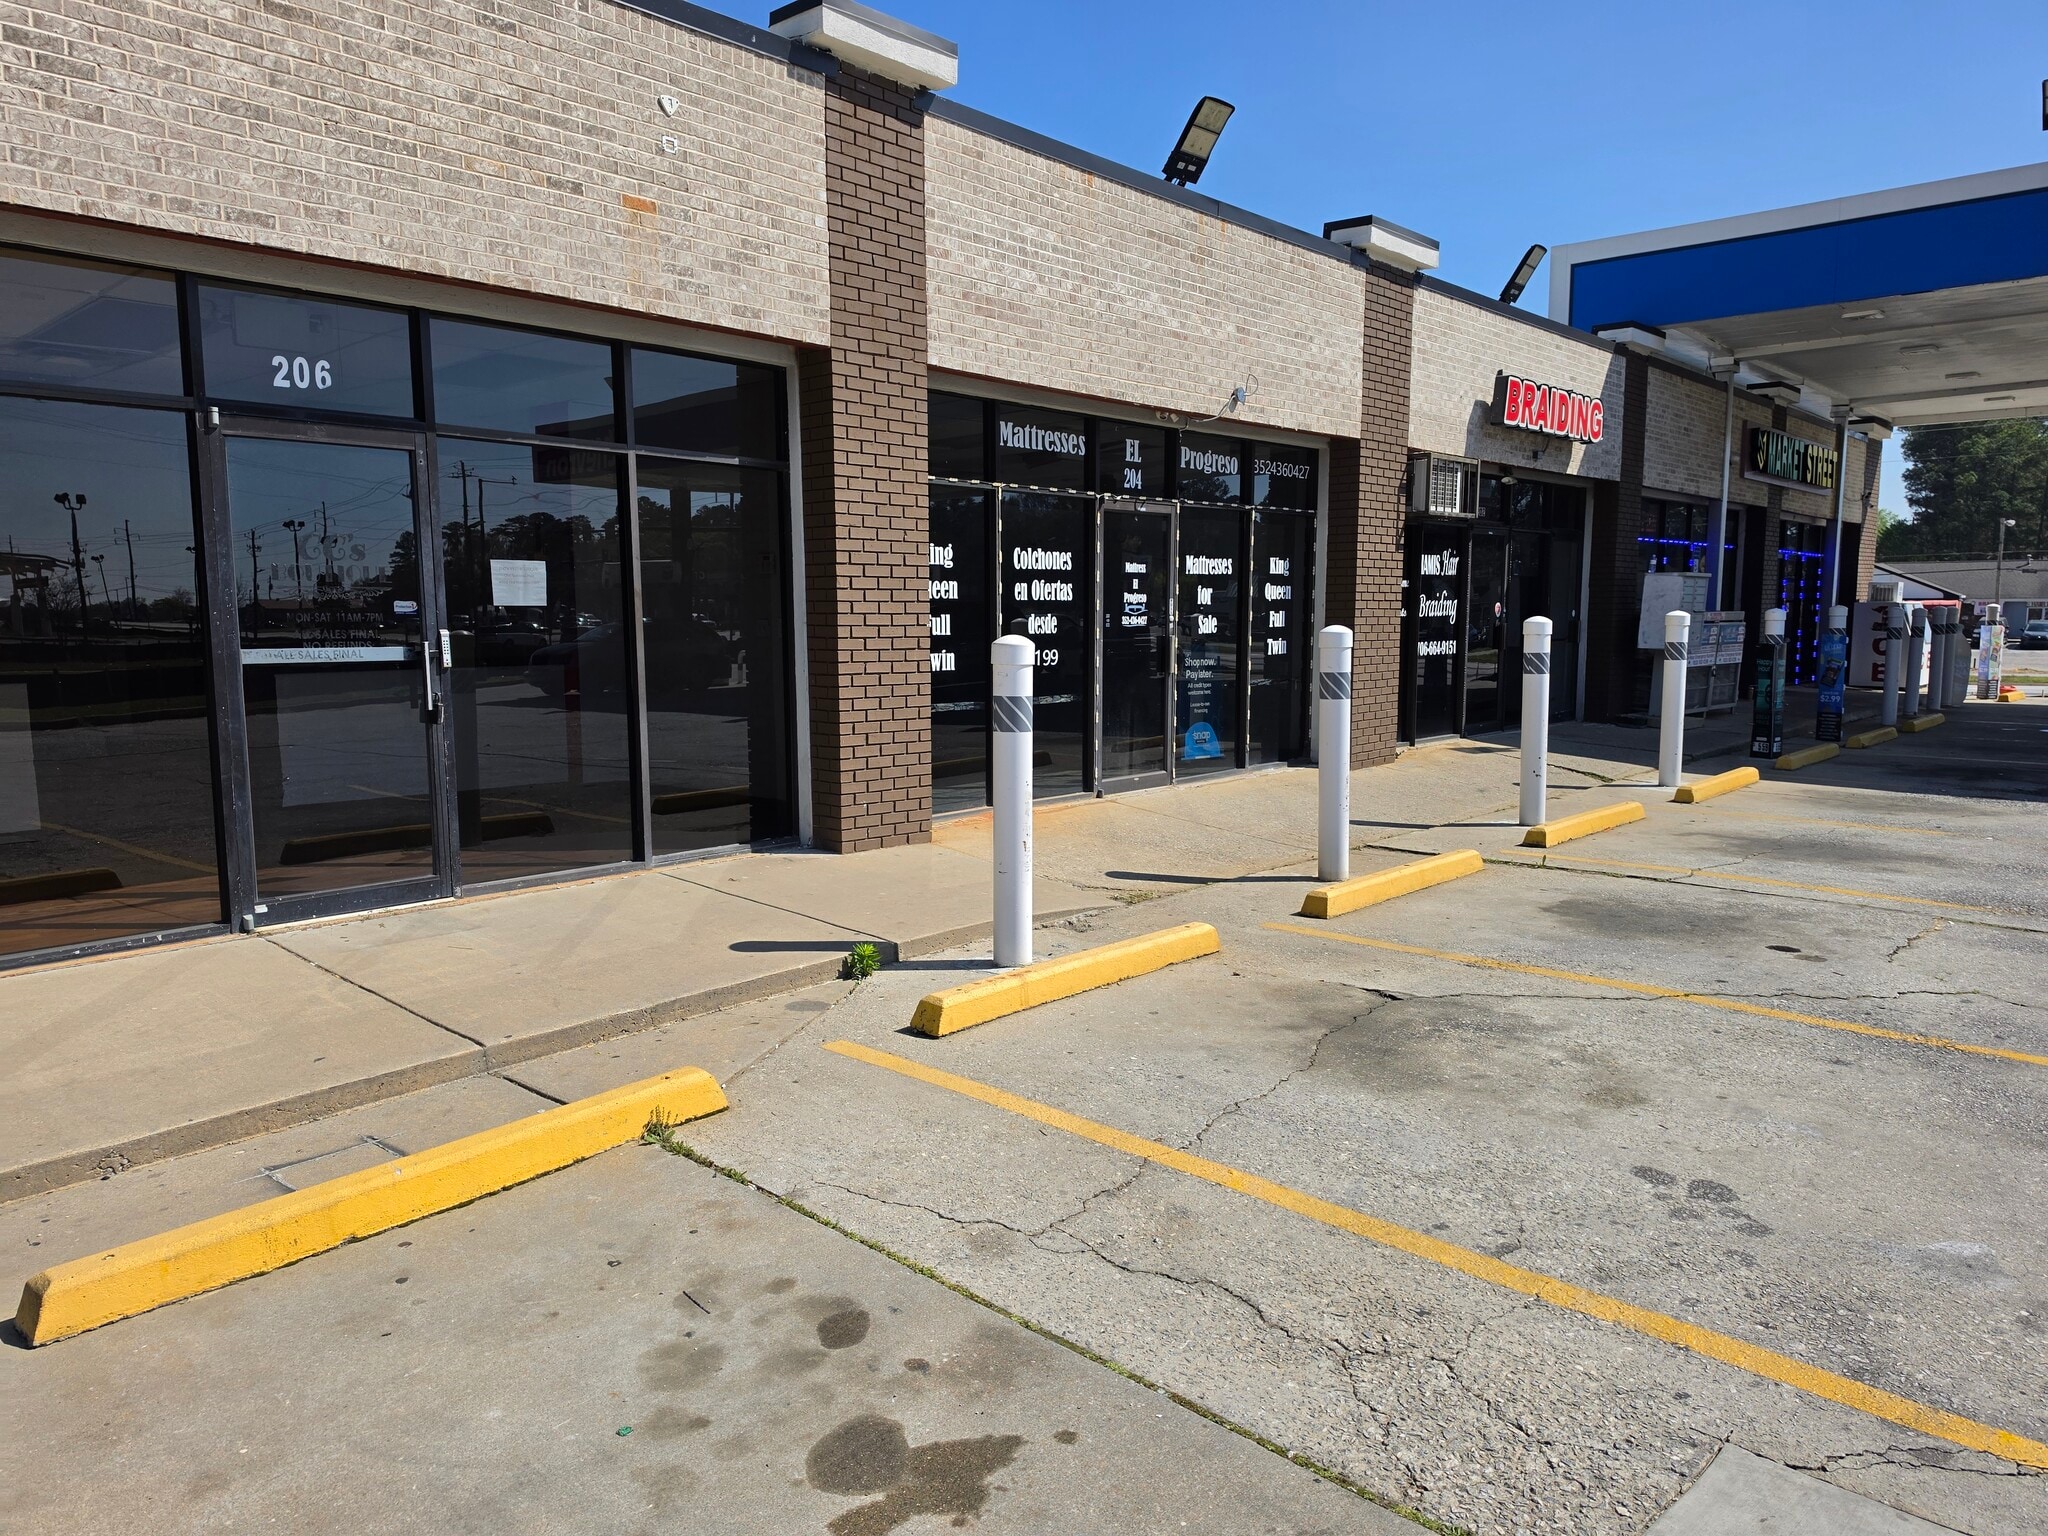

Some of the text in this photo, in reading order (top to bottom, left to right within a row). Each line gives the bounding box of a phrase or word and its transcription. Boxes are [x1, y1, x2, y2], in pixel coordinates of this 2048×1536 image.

[271, 355, 332, 390] 206
[1503, 376, 1604, 443] BRAIDING
[1000, 421, 1086, 456] Mattresses
[1125, 438, 1142, 463] EL
[1180, 446, 1239, 475] Progreso
[1767, 431, 1838, 489] MARKET STREET
[1123, 468, 1142, 489] 204
[1254, 459, 1310, 480] 3524360427
[928, 543, 954, 568] ing
[1013, 547, 1072, 571] Colchones
[1185, 555, 1233, 575] Mattresses
[1441, 547, 1460, 577] Hair
[1125, 562, 1147, 573] Mattress
[1269, 557, 1290, 577] King
[1014, 579, 1073, 601] en Ofertas
[1123, 592, 1147, 604] Progreso
[1197, 584, 1214, 605] for
[1264, 582, 1292, 602] Queen
[1418, 590, 1458, 625] Braiding
[1028, 613, 1057, 635] desde
[1198, 614, 1218, 635] Sale
[1268, 610, 1286, 628] Full
[1266, 638, 1287, 656] Twin
[930, 649, 956, 671] win
[1184, 657, 1200, 669] Shop
[1185, 669, 1214, 681] Pay later.
[1820, 694, 1841, 703] $2.99
[1192, 731, 1211, 742] snap
